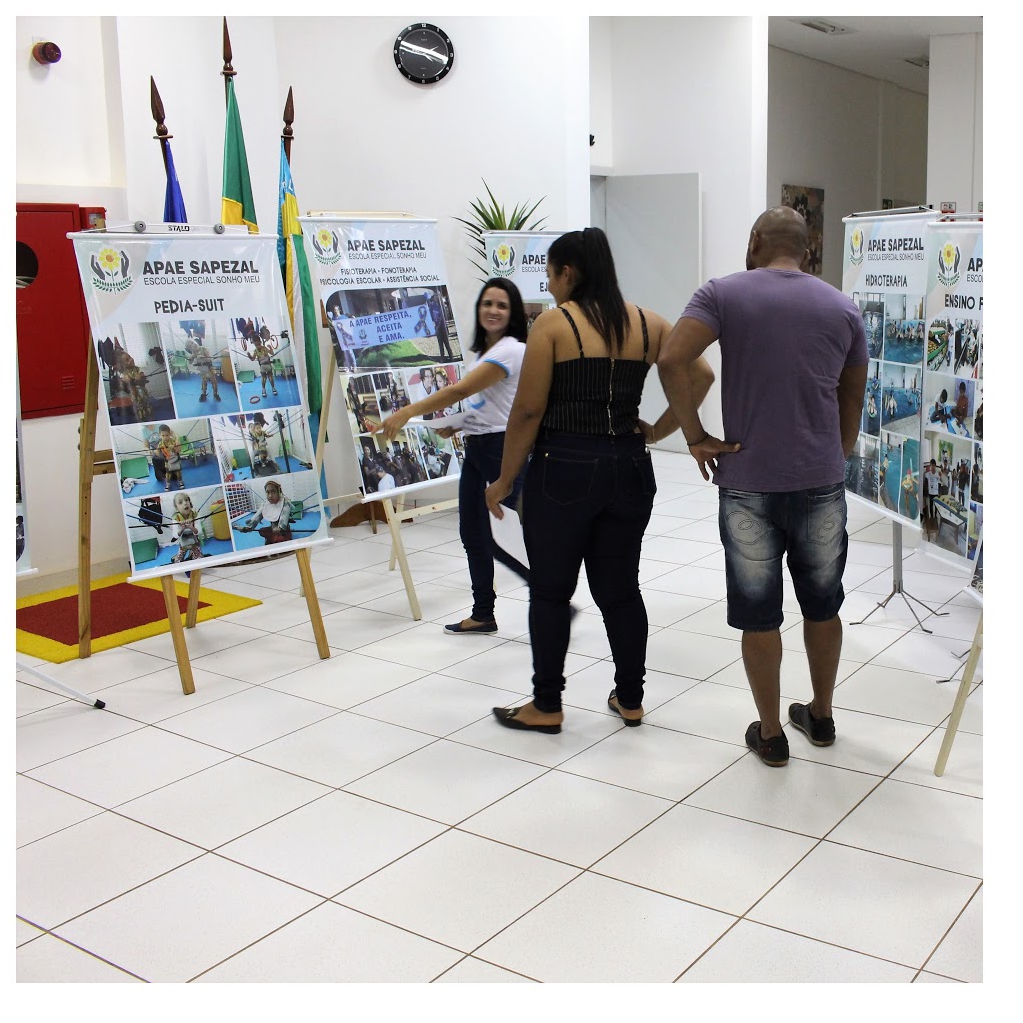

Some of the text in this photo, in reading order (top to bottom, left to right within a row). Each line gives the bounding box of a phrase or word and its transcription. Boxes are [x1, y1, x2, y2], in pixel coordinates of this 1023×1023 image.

[347, 239, 426, 252] APAE SAPEZAL
[868, 237, 924, 252] APAE SAPEZAL
[348, 252, 370, 260] ESCOLA
[371, 252, 396, 260] ESPECIAL
[521, 254, 546, 265] APAE
[142, 260, 259, 275] APAE SAPEZAL
[967, 258, 983, 272] AP
[340, 267, 377, 276] FISIOTERAPIA
[144, 275, 260, 286] ESCOLA ESPECIAL SONHO MEU
[356, 277, 382, 285] ESCOLAR
[386, 275, 419, 283] ASSISTÊNCIA
[420, 274, 440, 282] SOCIAL
[865, 274, 907, 287] HIDROTERAPIA
[967, 274, 983, 282] ESCO
[539, 282, 548, 292] EJ
[154, 298, 225, 314] PEDIA-SUIT
[944, 294, 975, 309] ENSINO
[356, 317, 372, 327] APAE
[374, 310, 412, 324] RESPEITA,
[377, 322, 403, 333] ACEITA
[378, 335, 384, 343] E
[385, 332, 405, 342] AMA.
